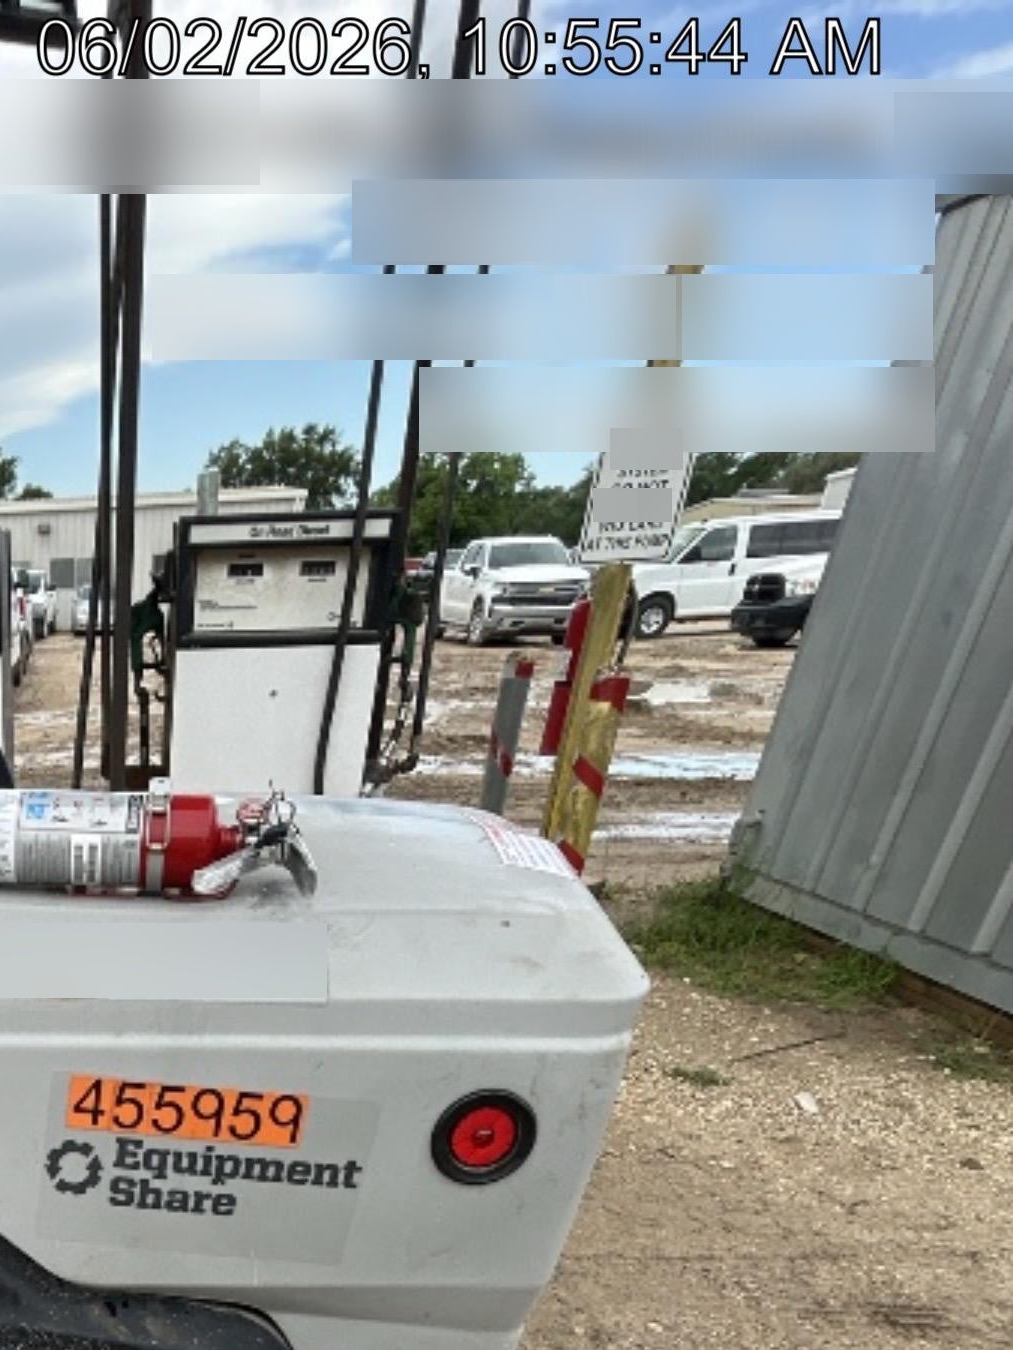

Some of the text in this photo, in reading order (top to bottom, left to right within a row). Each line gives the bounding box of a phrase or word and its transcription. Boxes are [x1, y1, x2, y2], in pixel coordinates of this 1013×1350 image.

[73, 1078, 303, 1143] 455959
[112, 1136, 363, 1189] Equipment
[108, 1175, 237, 1216] Share
